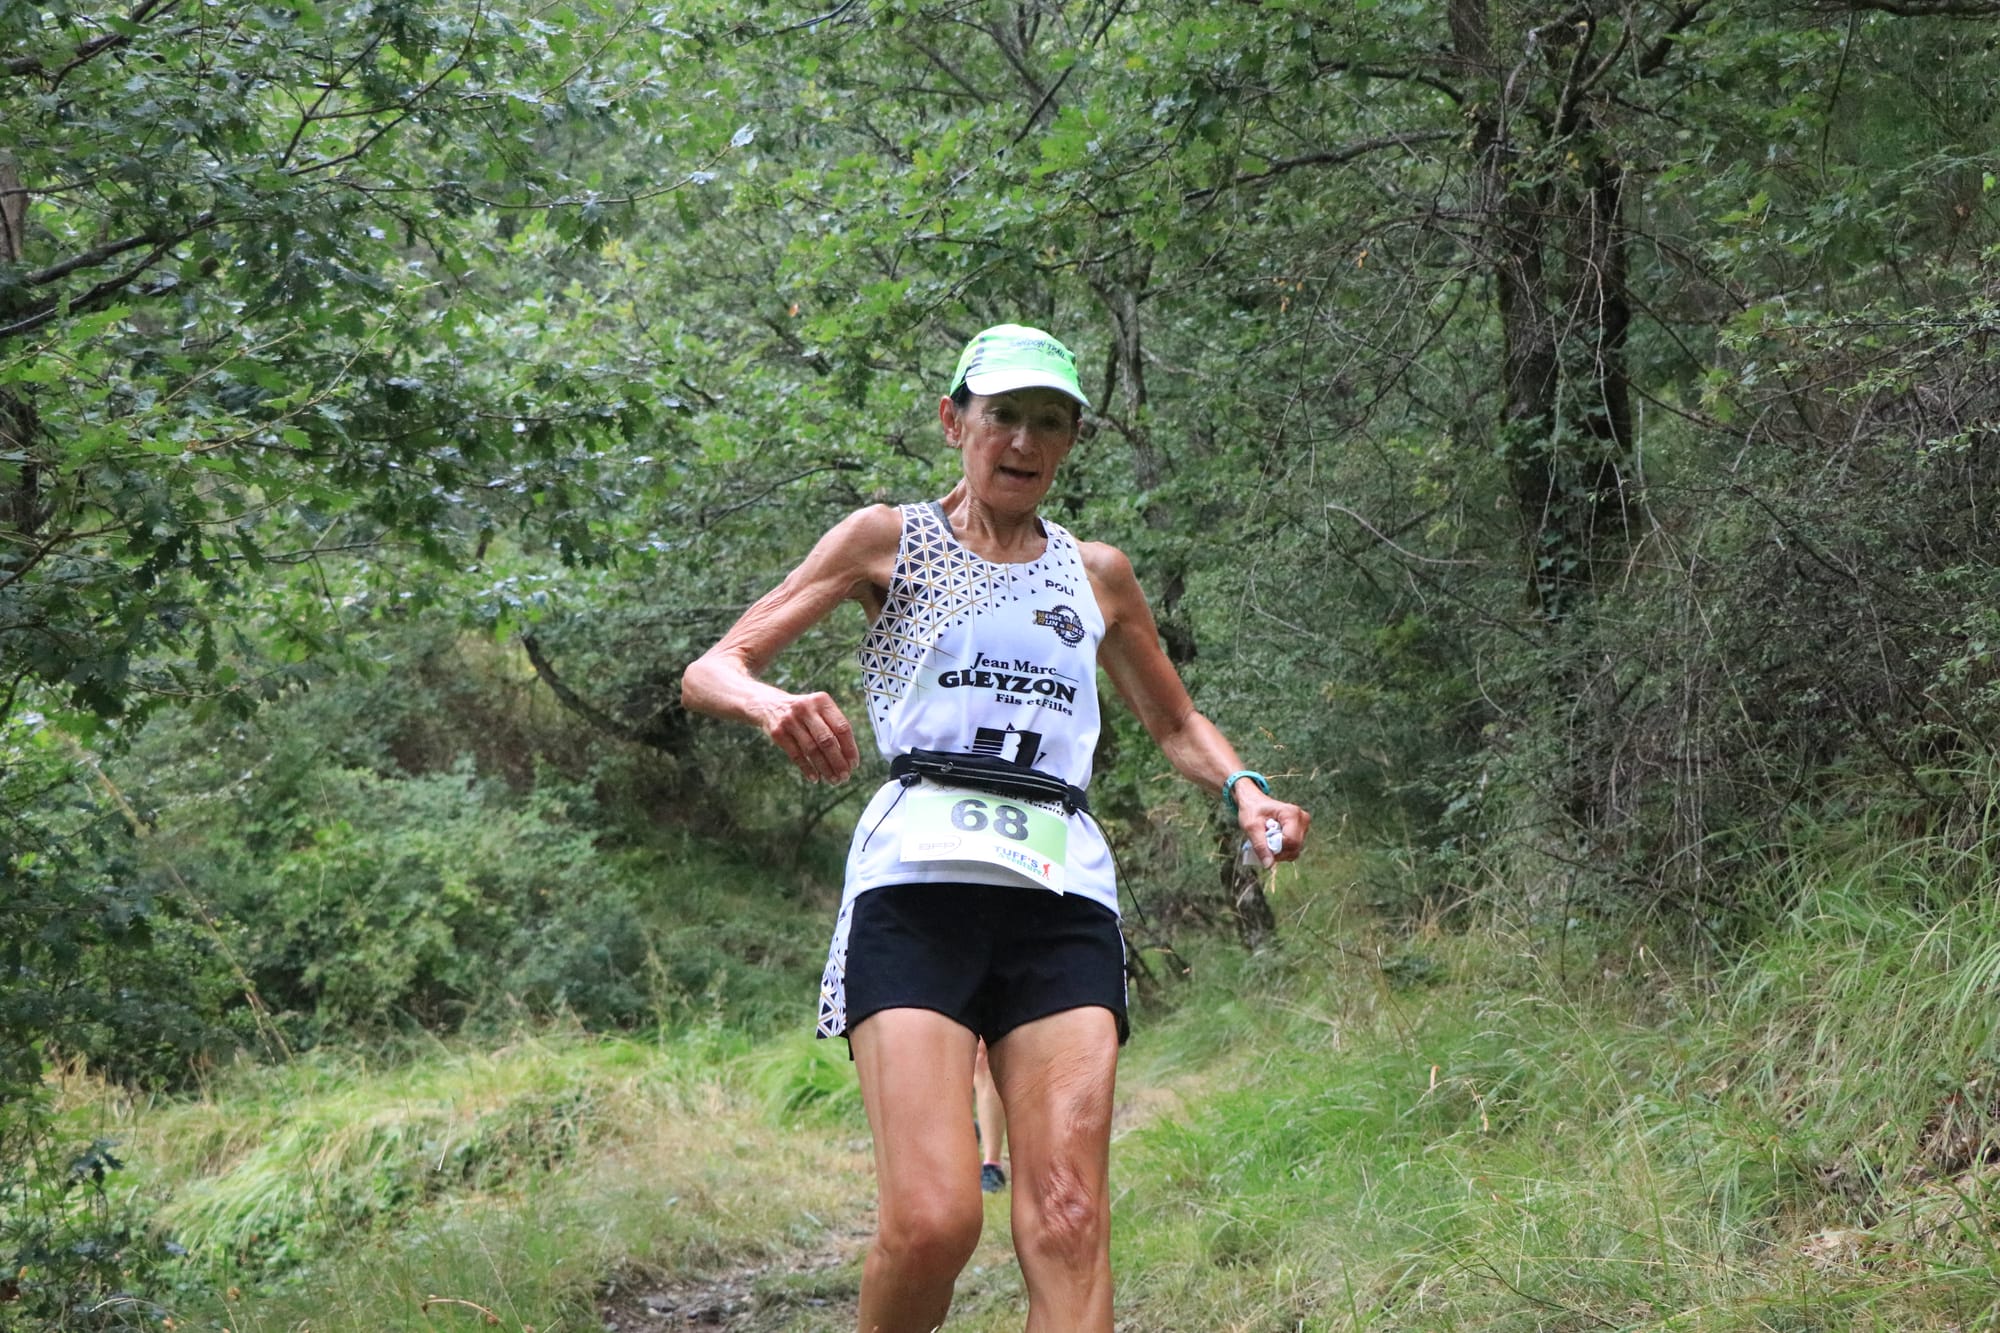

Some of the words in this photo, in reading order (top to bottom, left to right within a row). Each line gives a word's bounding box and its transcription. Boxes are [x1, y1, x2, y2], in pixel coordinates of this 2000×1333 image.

[1045, 578, 1074, 597] POLI
[970, 652, 1010, 670] Jean
[1013, 659, 1057, 676] Marc
[938, 669, 1077, 704] GLEYZON
[995, 693, 1022, 706] Fils
[951, 798, 1029, 841] 68
